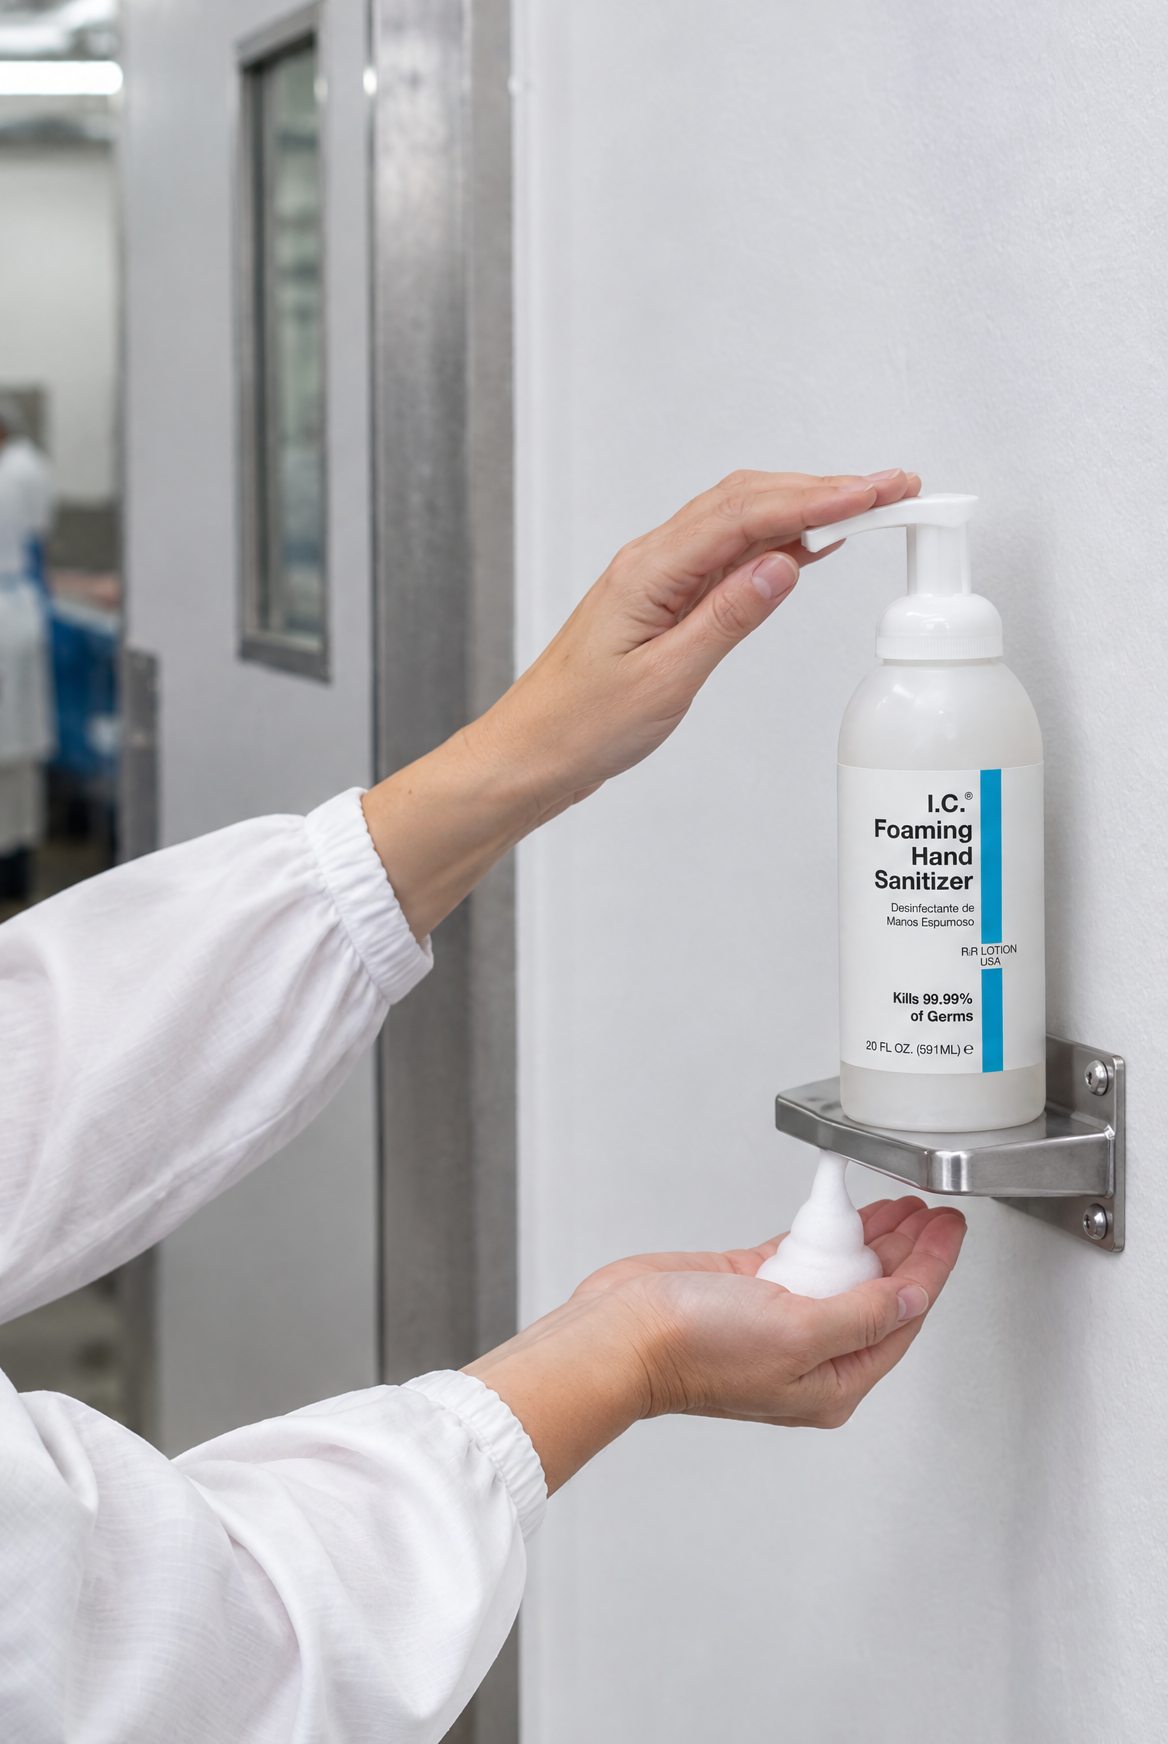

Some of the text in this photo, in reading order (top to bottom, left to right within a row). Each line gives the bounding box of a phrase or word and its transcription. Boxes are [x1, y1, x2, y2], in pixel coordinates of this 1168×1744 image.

[874, 819, 972, 843] Foaming
[912, 846, 972, 866] Hand
[875, 870, 973, 890] Sanitizer
[891, 903, 974, 913] Desinfectante de
[887, 916, 974, 929] Manos Espumoso
[981, 943, 1017, 955] LOTION
[981, 957, 1001, 966] USA
[893, 992, 973, 1005] Kills 99.99%
[911, 1010, 973, 1022] of Germs
[866, 1040, 877, 1051] 20
[880, 1042, 892, 1052] FL
[895, 1043, 913, 1054] OZ.
